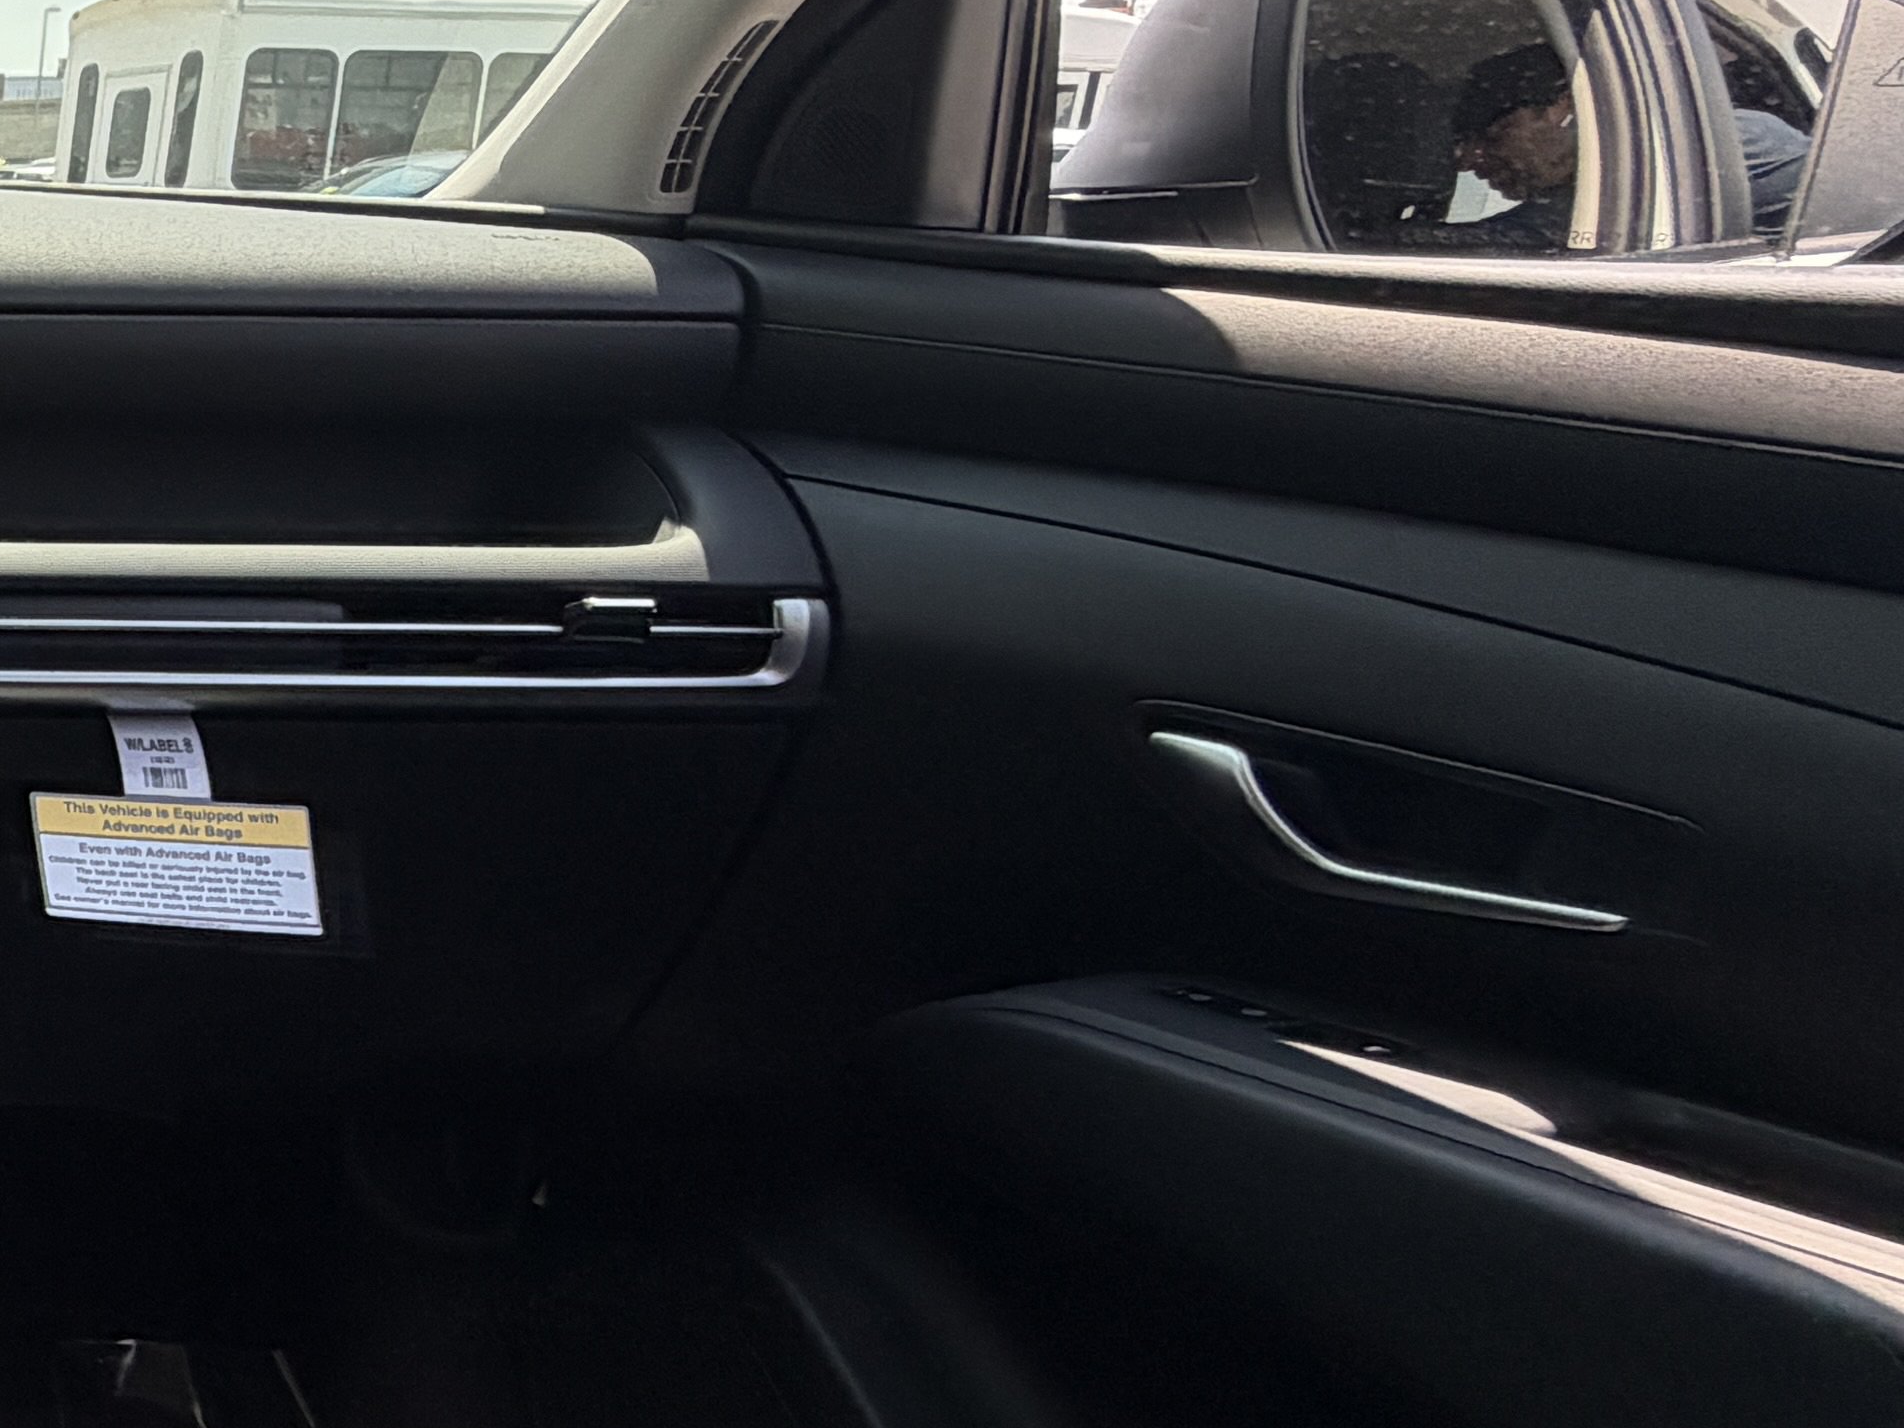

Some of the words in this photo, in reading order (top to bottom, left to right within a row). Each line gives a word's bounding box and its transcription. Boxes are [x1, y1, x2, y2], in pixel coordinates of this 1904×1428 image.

[63, 801, 95, 814] This
[99, 803, 152, 818] Vehicle
[156, 806, 169, 818] is
[173, 807, 243, 824] Equipped
[247, 811, 279, 824] with
[102, 819, 175, 835] Advanced
[179, 822, 200, 836] Air
[205, 825, 243, 840] Bags
[79, 842, 111, 855] Even
[114, 845, 142, 858] with
[146, 847, 210, 862] Advanced
[214, 849, 233, 862] Air
[236, 851, 272, 866] Bags
